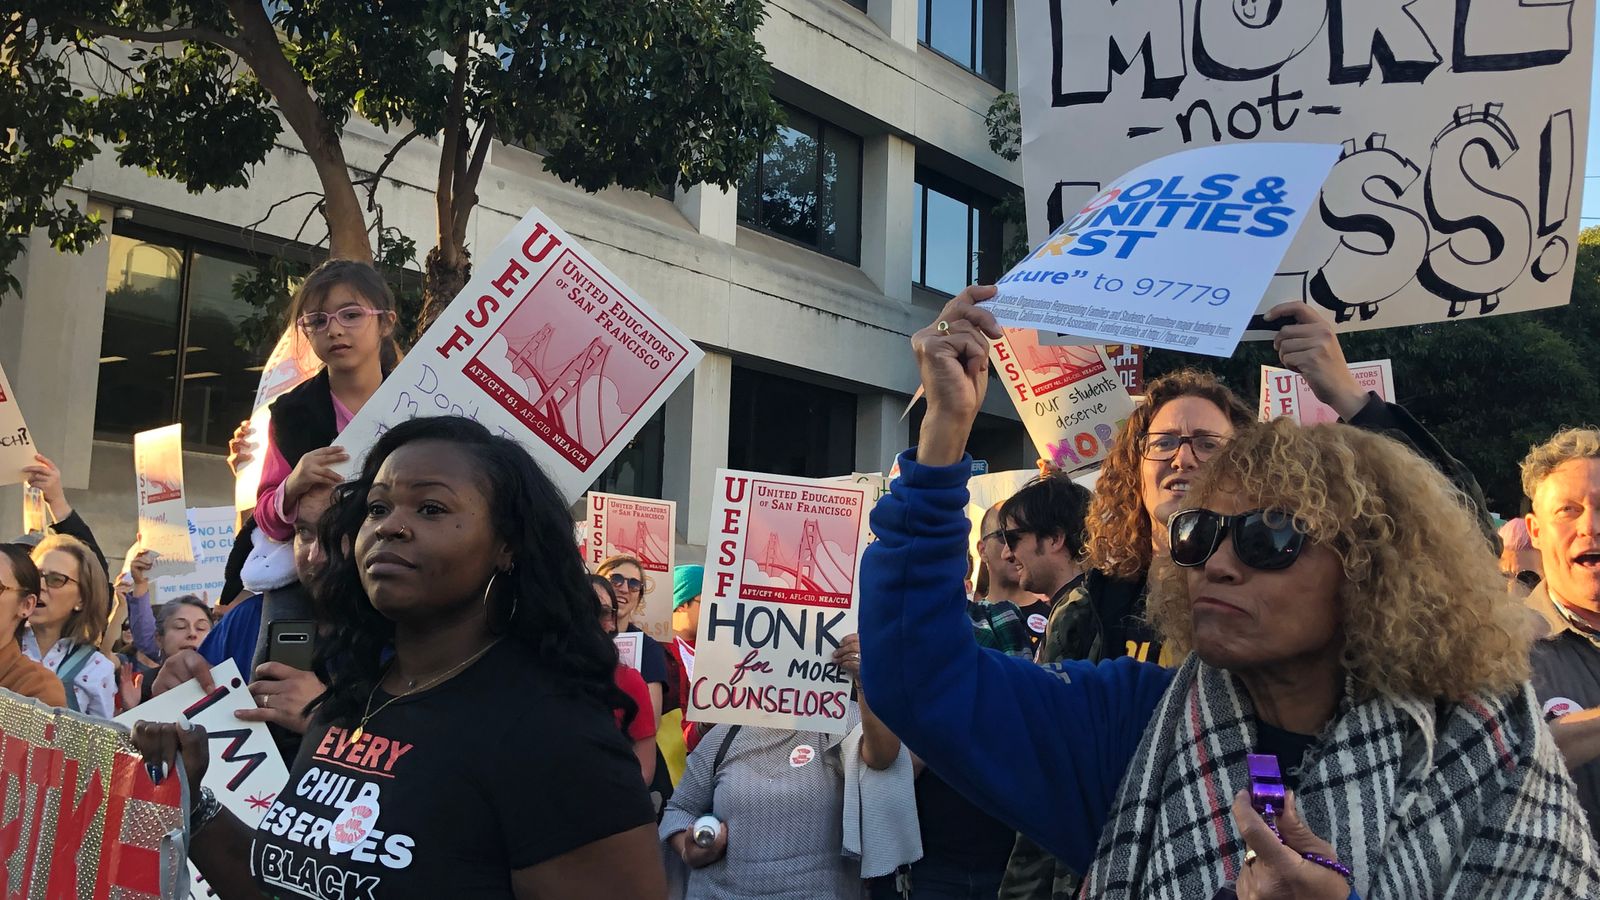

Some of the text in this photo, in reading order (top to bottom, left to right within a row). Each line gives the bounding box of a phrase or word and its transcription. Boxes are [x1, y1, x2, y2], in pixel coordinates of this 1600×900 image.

[1242, 176, 1288, 205] &
[436, 222, 562, 359] UESF
[561, 259, 676, 363] UNITED EDUCATORS
[1093, 273, 1123, 292] to
[1132, 277, 1231, 307] 97779
[567, 287, 594, 314] SAN
[594, 310, 661, 371] FRANCISCO
[469, 365, 505, 395] AFT/CFT
[552, 433, 588, 466] NEA/CTA
[1035, 376, 1117, 417] our students
[1056, 401, 1107, 430] deserve
[1046, 418, 1126, 469] MOR
[757, 486, 857, 506] UNITED EDUCATORS
[771, 499, 795, 511] SAN
[796, 502, 852, 517] FRANCISCO
[198, 526, 215, 536] NO
[592, 495, 605, 563] UESF
[715, 476, 748, 598] UESF
[707, 602, 847, 656] HONK
[730, 650, 850, 686] for MORE
[692, 676, 849, 719] COUNSELORS
[316, 725, 414, 772] EVERY
[296, 766, 381, 810] CHILD
[260, 801, 416, 869] ESERES
[261, 843, 381, 900] BLACK
